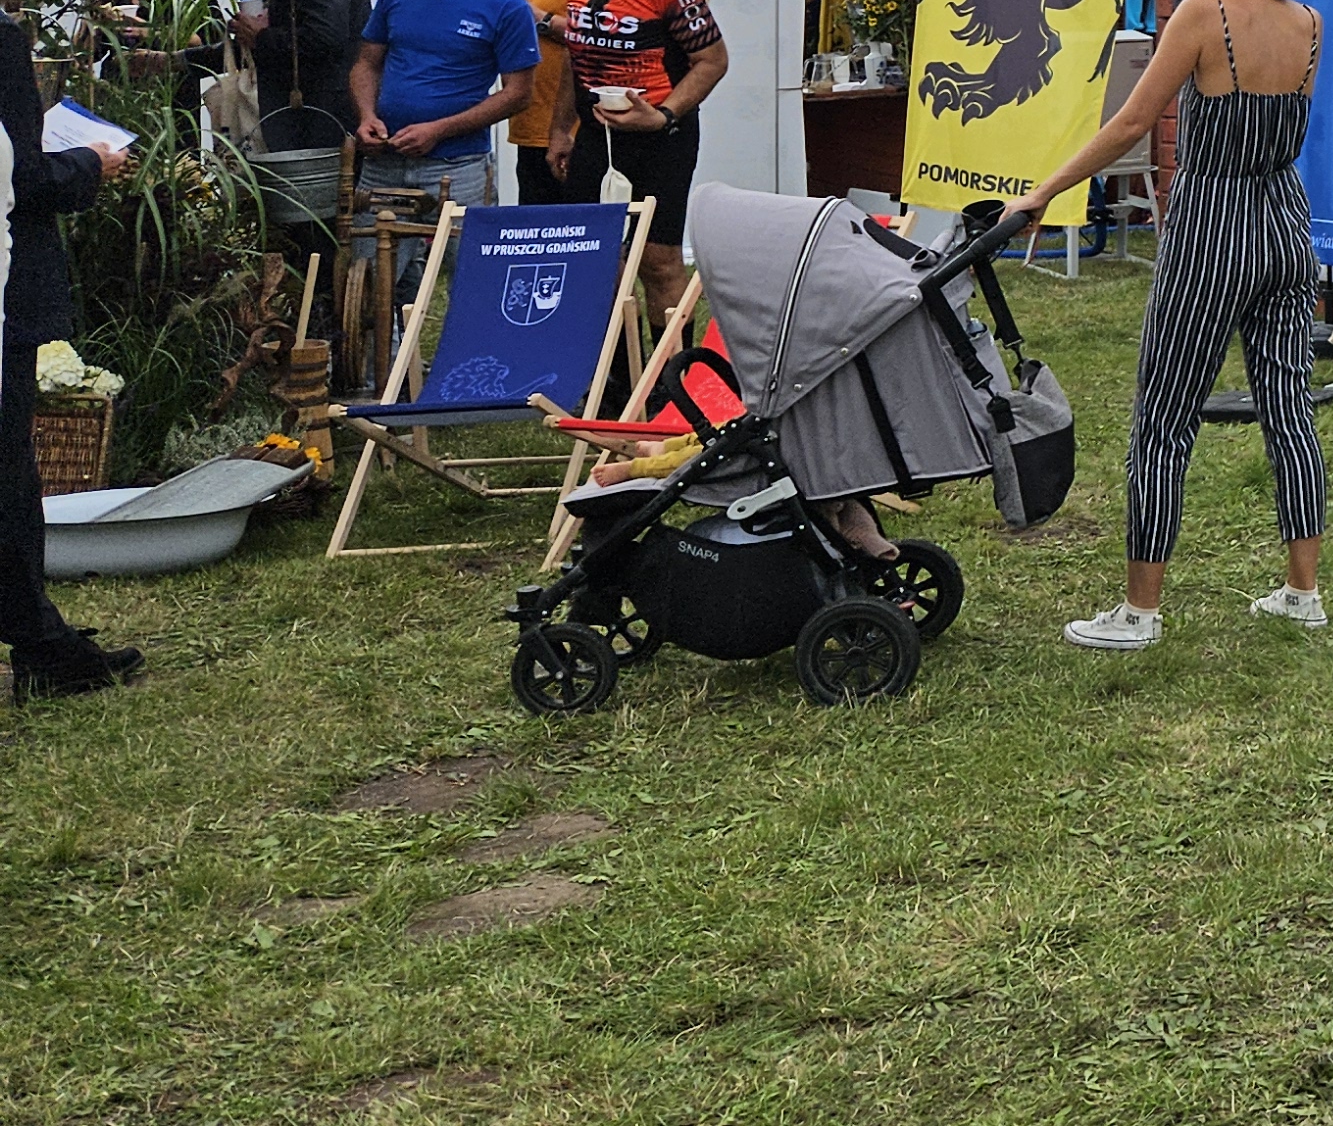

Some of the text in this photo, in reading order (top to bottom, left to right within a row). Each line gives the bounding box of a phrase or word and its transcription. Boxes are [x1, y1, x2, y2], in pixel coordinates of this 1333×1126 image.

[918, 162, 1040, 196] POMORSKIE
[500, 224, 586, 240] POWIAT GDAŃSKI
[481, 240, 600, 256] W PRUSZCZU GDAŃSKIM
[678, 540, 719, 562] SNAP4
